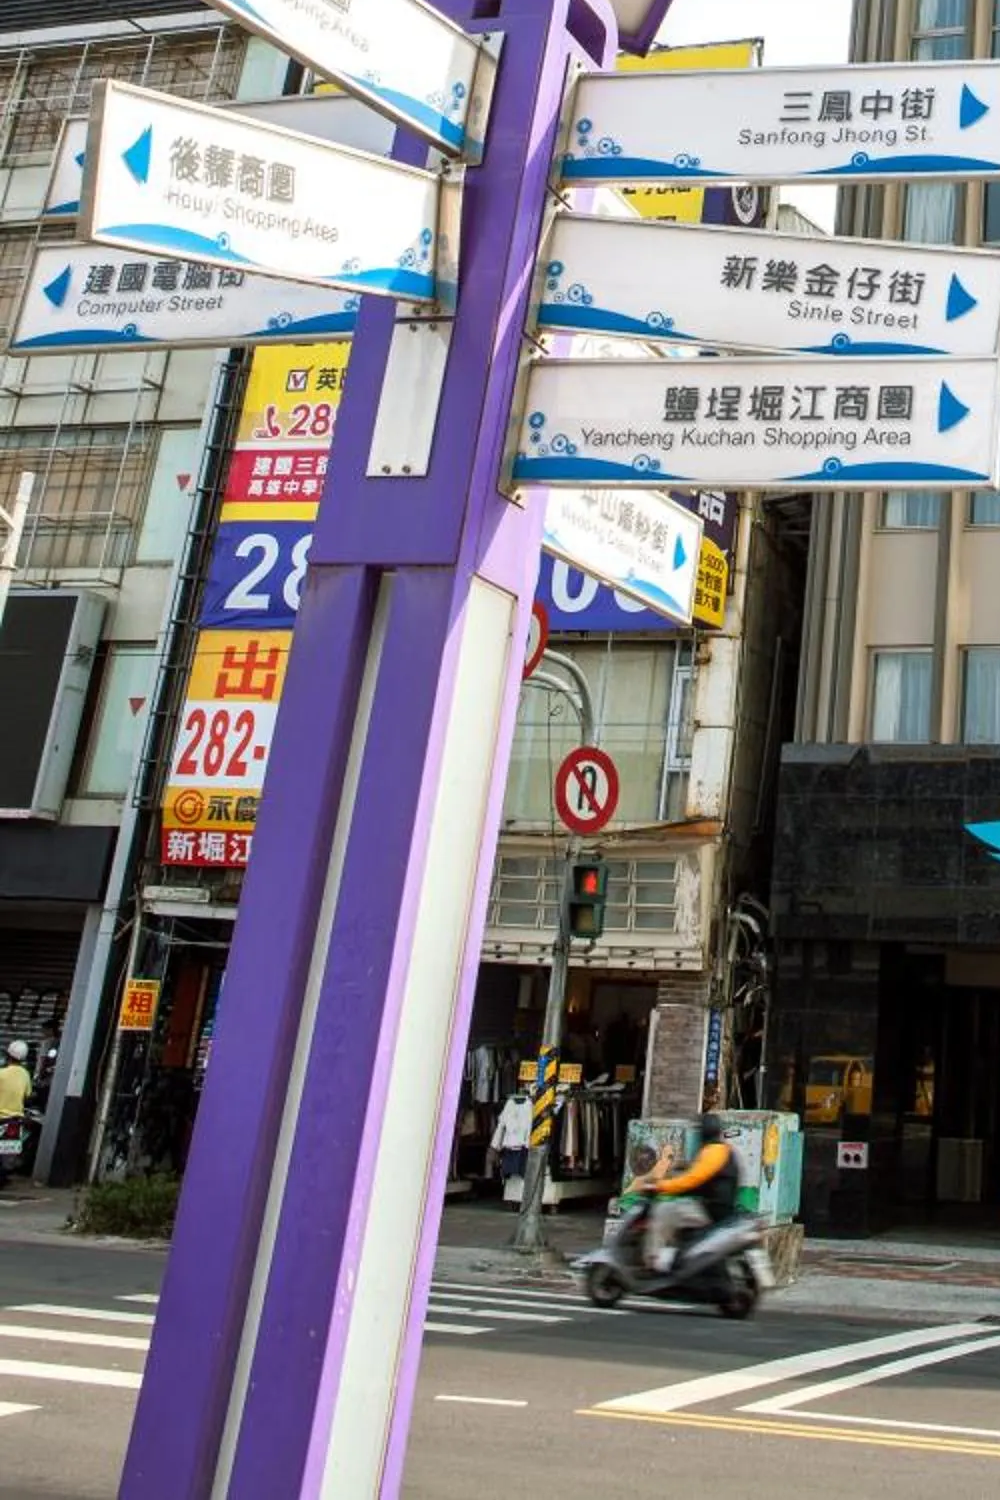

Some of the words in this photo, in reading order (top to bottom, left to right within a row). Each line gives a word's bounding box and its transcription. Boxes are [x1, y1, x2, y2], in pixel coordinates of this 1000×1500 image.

[779, 87, 936, 122] 三鳳中街
[737, 128, 826, 148] Sanfong
[831, 126, 897, 147] Jhong
[223, 197, 301, 239] Shopping
[302, 217, 340, 243] Area
[720, 254, 926, 306] 新樂金仔街
[77, 299, 166, 318] Computer
[168, 295, 225, 312] Street
[787, 299, 843, 323] Sinle
[850, 305, 919, 329] Street
[663, 385, 915, 423] 鹽埕堀江商圈
[580, 426, 674, 449] Yancheng
[681, 427, 755, 446] Kuchan
[763, 427, 857, 449] Shopping
[863, 428, 912, 446] Area
[214, 639, 280, 700] 出
